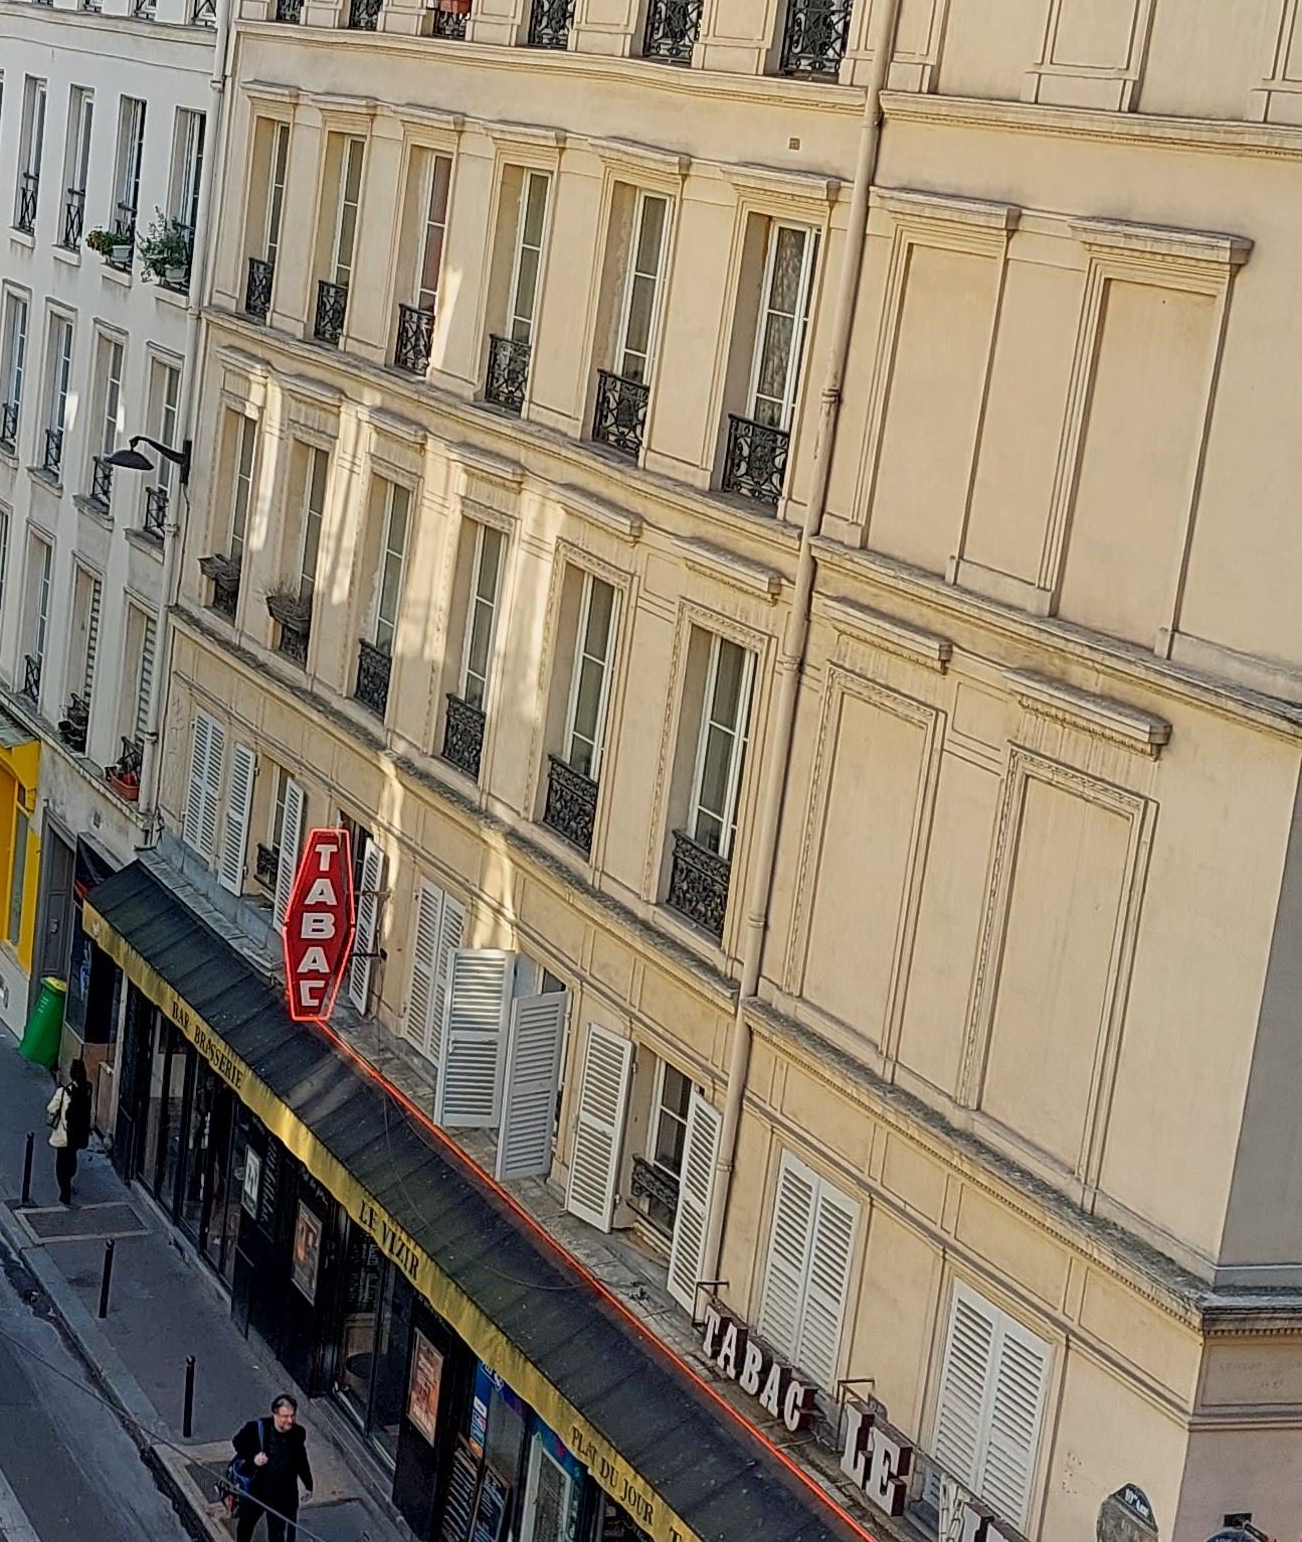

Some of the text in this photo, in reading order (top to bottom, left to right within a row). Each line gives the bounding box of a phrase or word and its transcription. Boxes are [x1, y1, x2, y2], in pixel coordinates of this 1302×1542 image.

[296, 843, 338, 1007] TABAC
[171, 1001, 243, 1089] BAR BRASSERIE
[381, 1219, 419, 1281] VIZIR
[703, 1305, 808, 1432] TABAC
[840, 1400, 905, 1517] LE
[571, 1425, 598, 1465] PLAT
[600, 1457, 619, 1488] DU
[620, 1478, 654, 1526] JOUR
